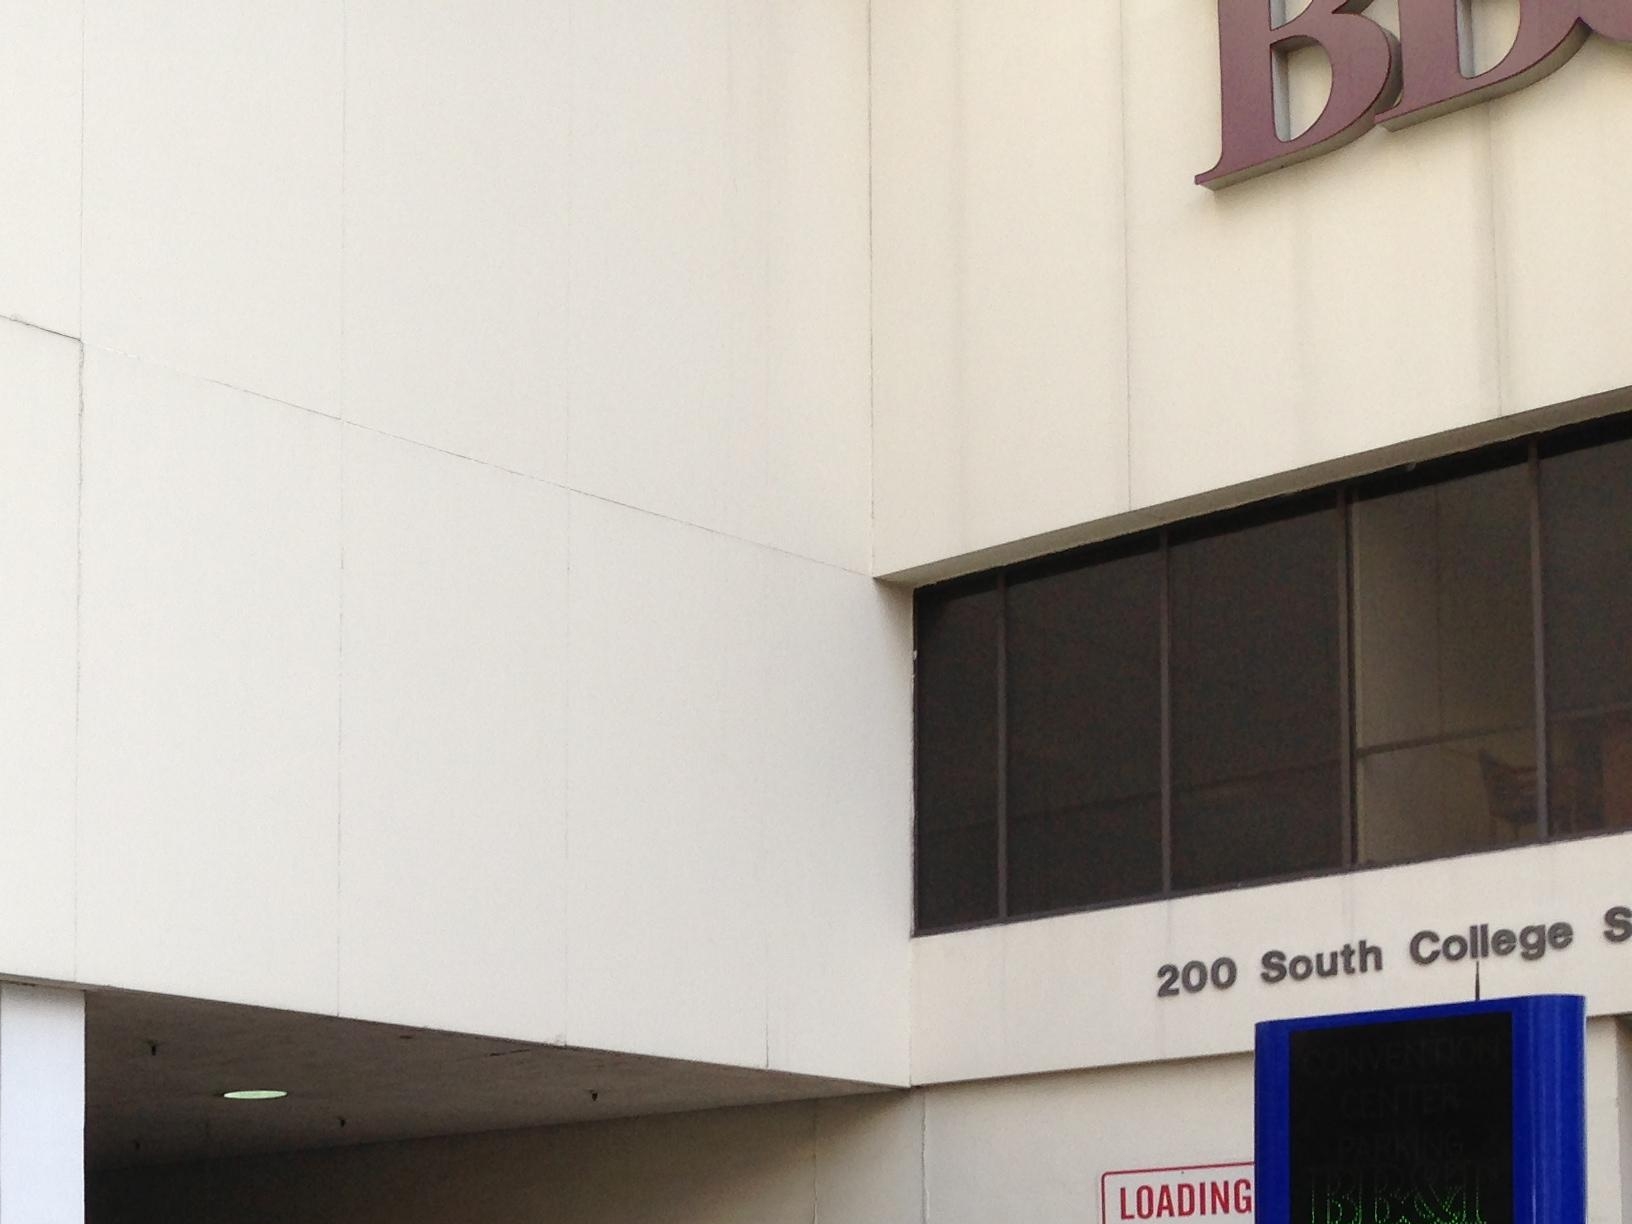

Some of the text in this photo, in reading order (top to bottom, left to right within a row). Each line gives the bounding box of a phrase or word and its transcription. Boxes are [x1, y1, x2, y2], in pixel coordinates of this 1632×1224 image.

[1157, 956, 1238, 998] 200
[1260, 940, 1383, 984] South
[1409, 920, 1574, 961] College
[1120, 1178, 1253, 1220] LOADING
